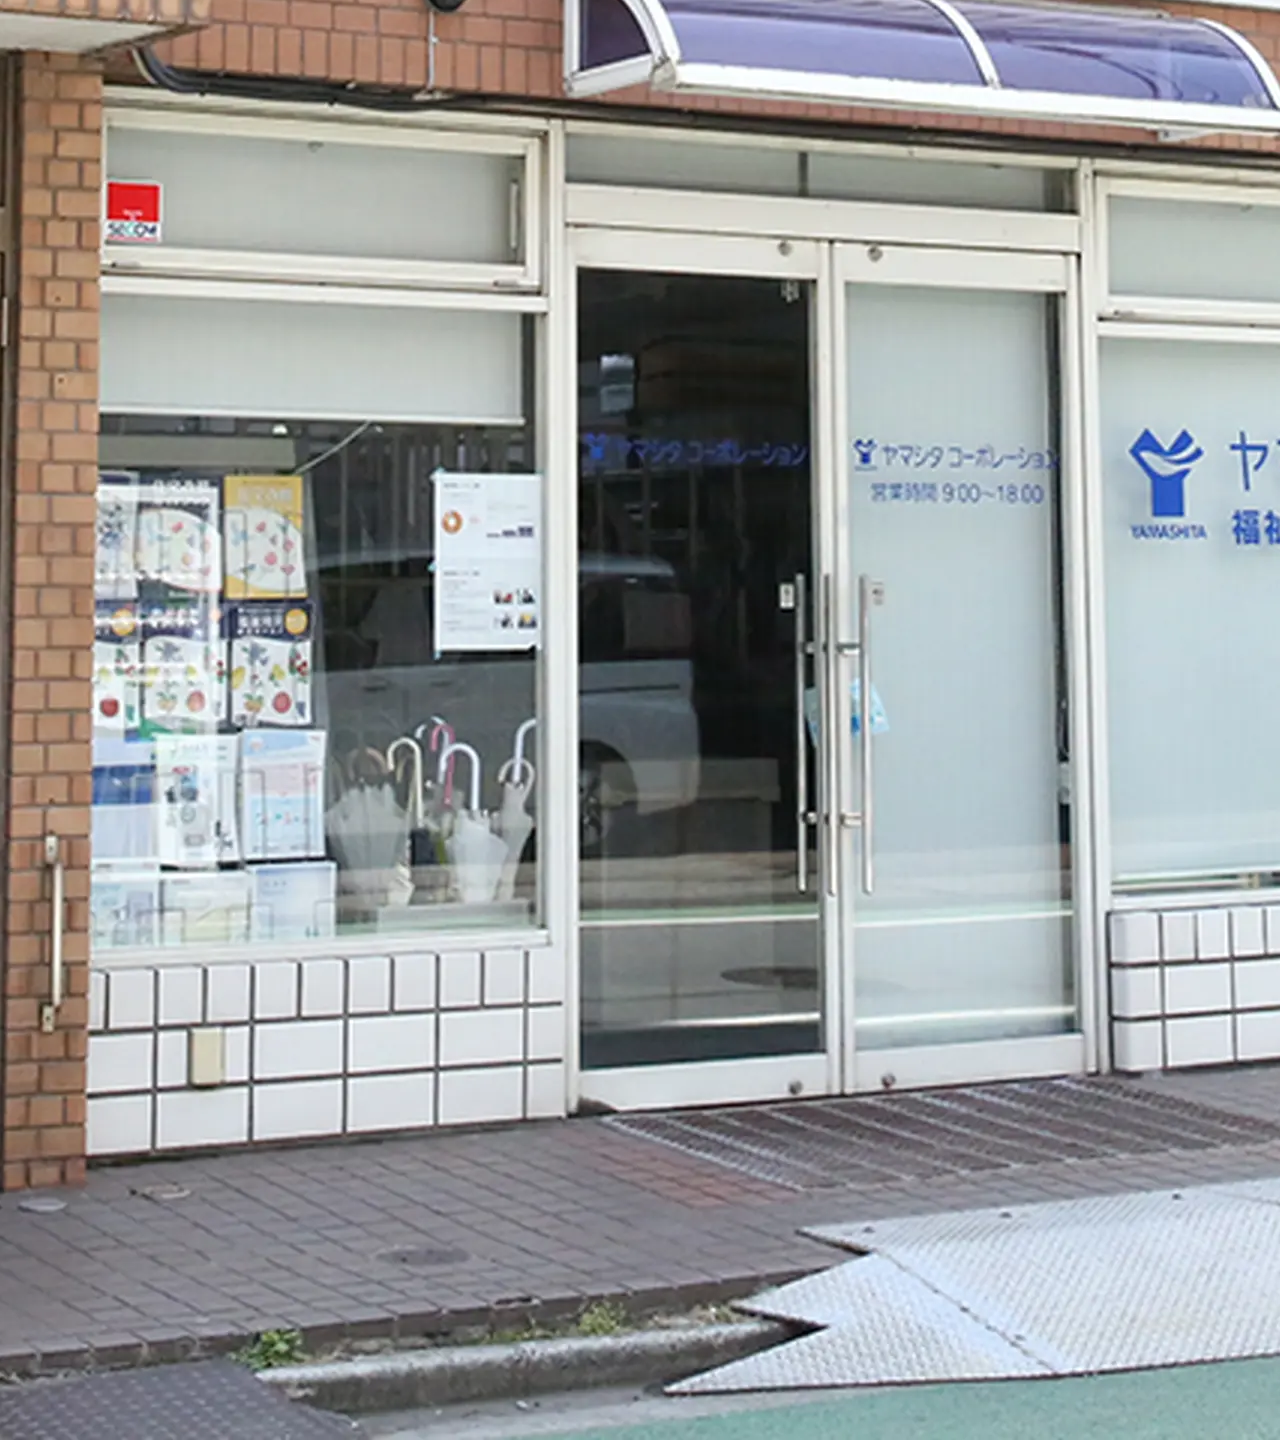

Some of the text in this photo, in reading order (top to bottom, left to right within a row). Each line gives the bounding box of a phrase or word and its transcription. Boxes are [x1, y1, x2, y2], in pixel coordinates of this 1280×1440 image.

[882, 444, 1060, 470] ヤマシタ コーポレーション
[871, 482, 938, 503] 営業時間
[1130, 524, 1207, 540] YAMASHITA
